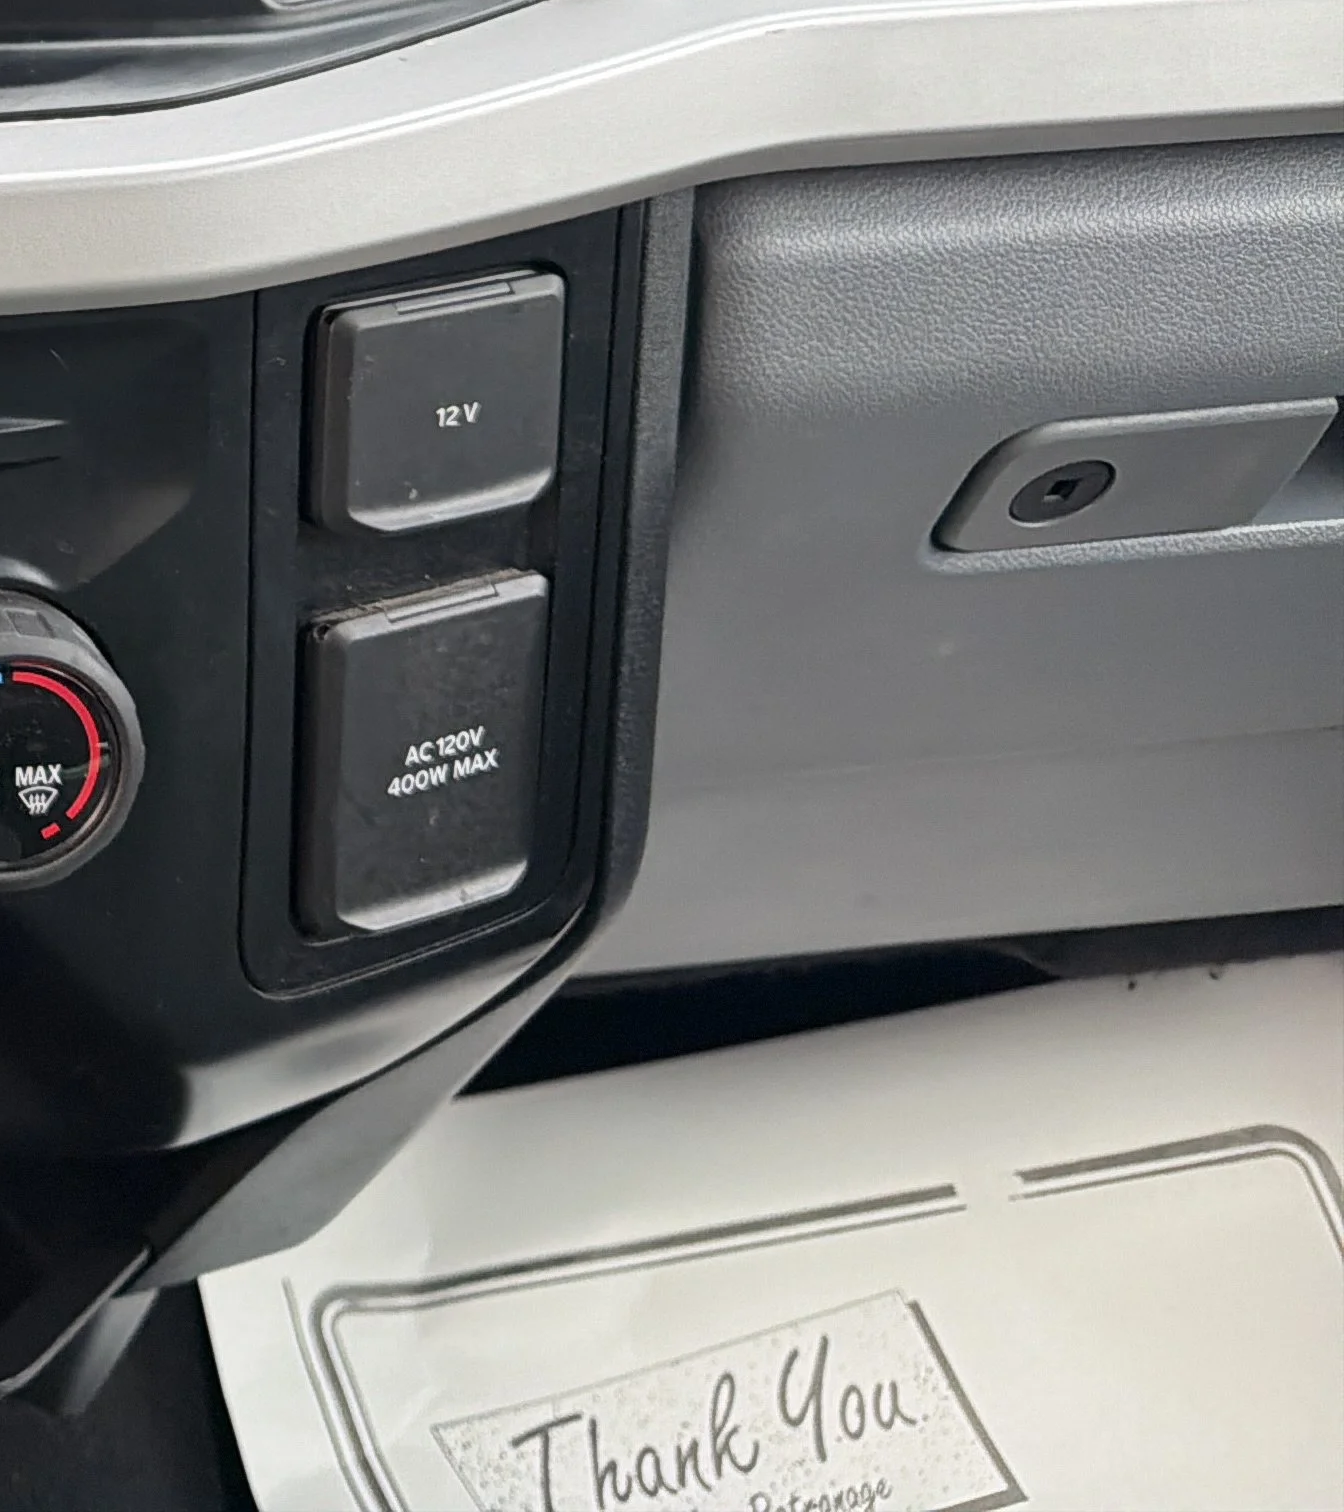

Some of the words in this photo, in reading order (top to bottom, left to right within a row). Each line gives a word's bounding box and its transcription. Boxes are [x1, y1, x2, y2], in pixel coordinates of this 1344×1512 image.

[405, 740, 436, 768] AC
[436, 725, 485, 757] 120V
[14, 764, 62, 786] MAX
[387, 763, 448, 797] 400W
[452, 748, 500, 782] MAX
[512, 1372, 760, 1512] Thank
[779, 1335, 916, 1463] You
